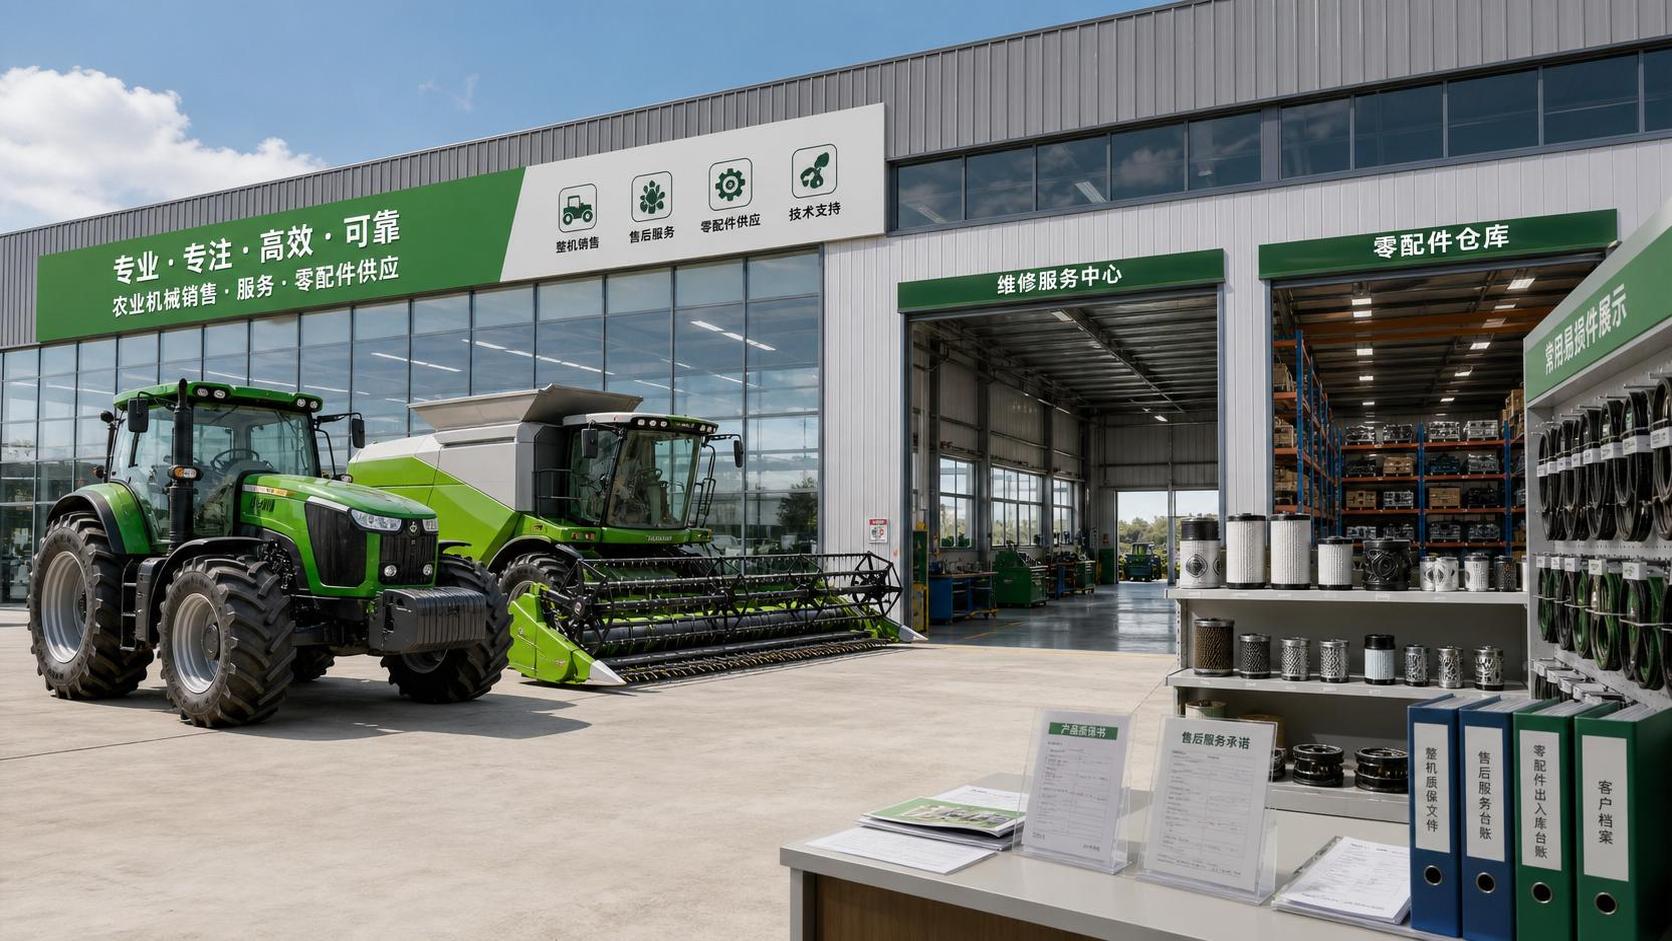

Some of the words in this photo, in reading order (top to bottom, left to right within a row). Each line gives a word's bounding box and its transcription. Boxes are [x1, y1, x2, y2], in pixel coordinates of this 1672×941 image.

[700, 213, 761, 233] 零配件供应
[789, 202, 841, 221] 技术支持
[556, 237, 600, 254] 整机销售
[629, 225, 675, 244] 售后服务
[1373, 224, 1511, 259] 零配件仓库
[996, 264, 1123, 296] 维修服务中心
[1544, 283, 1628, 376] 常用易损件展示
[1181, 731, 1251, 750] 售后服务承诺
[1425, 747, 1438, 833] 整机质保文件
[1478, 751, 1492, 840] 售后服务台账
[1598, 780, 1613, 845] 客户档案
